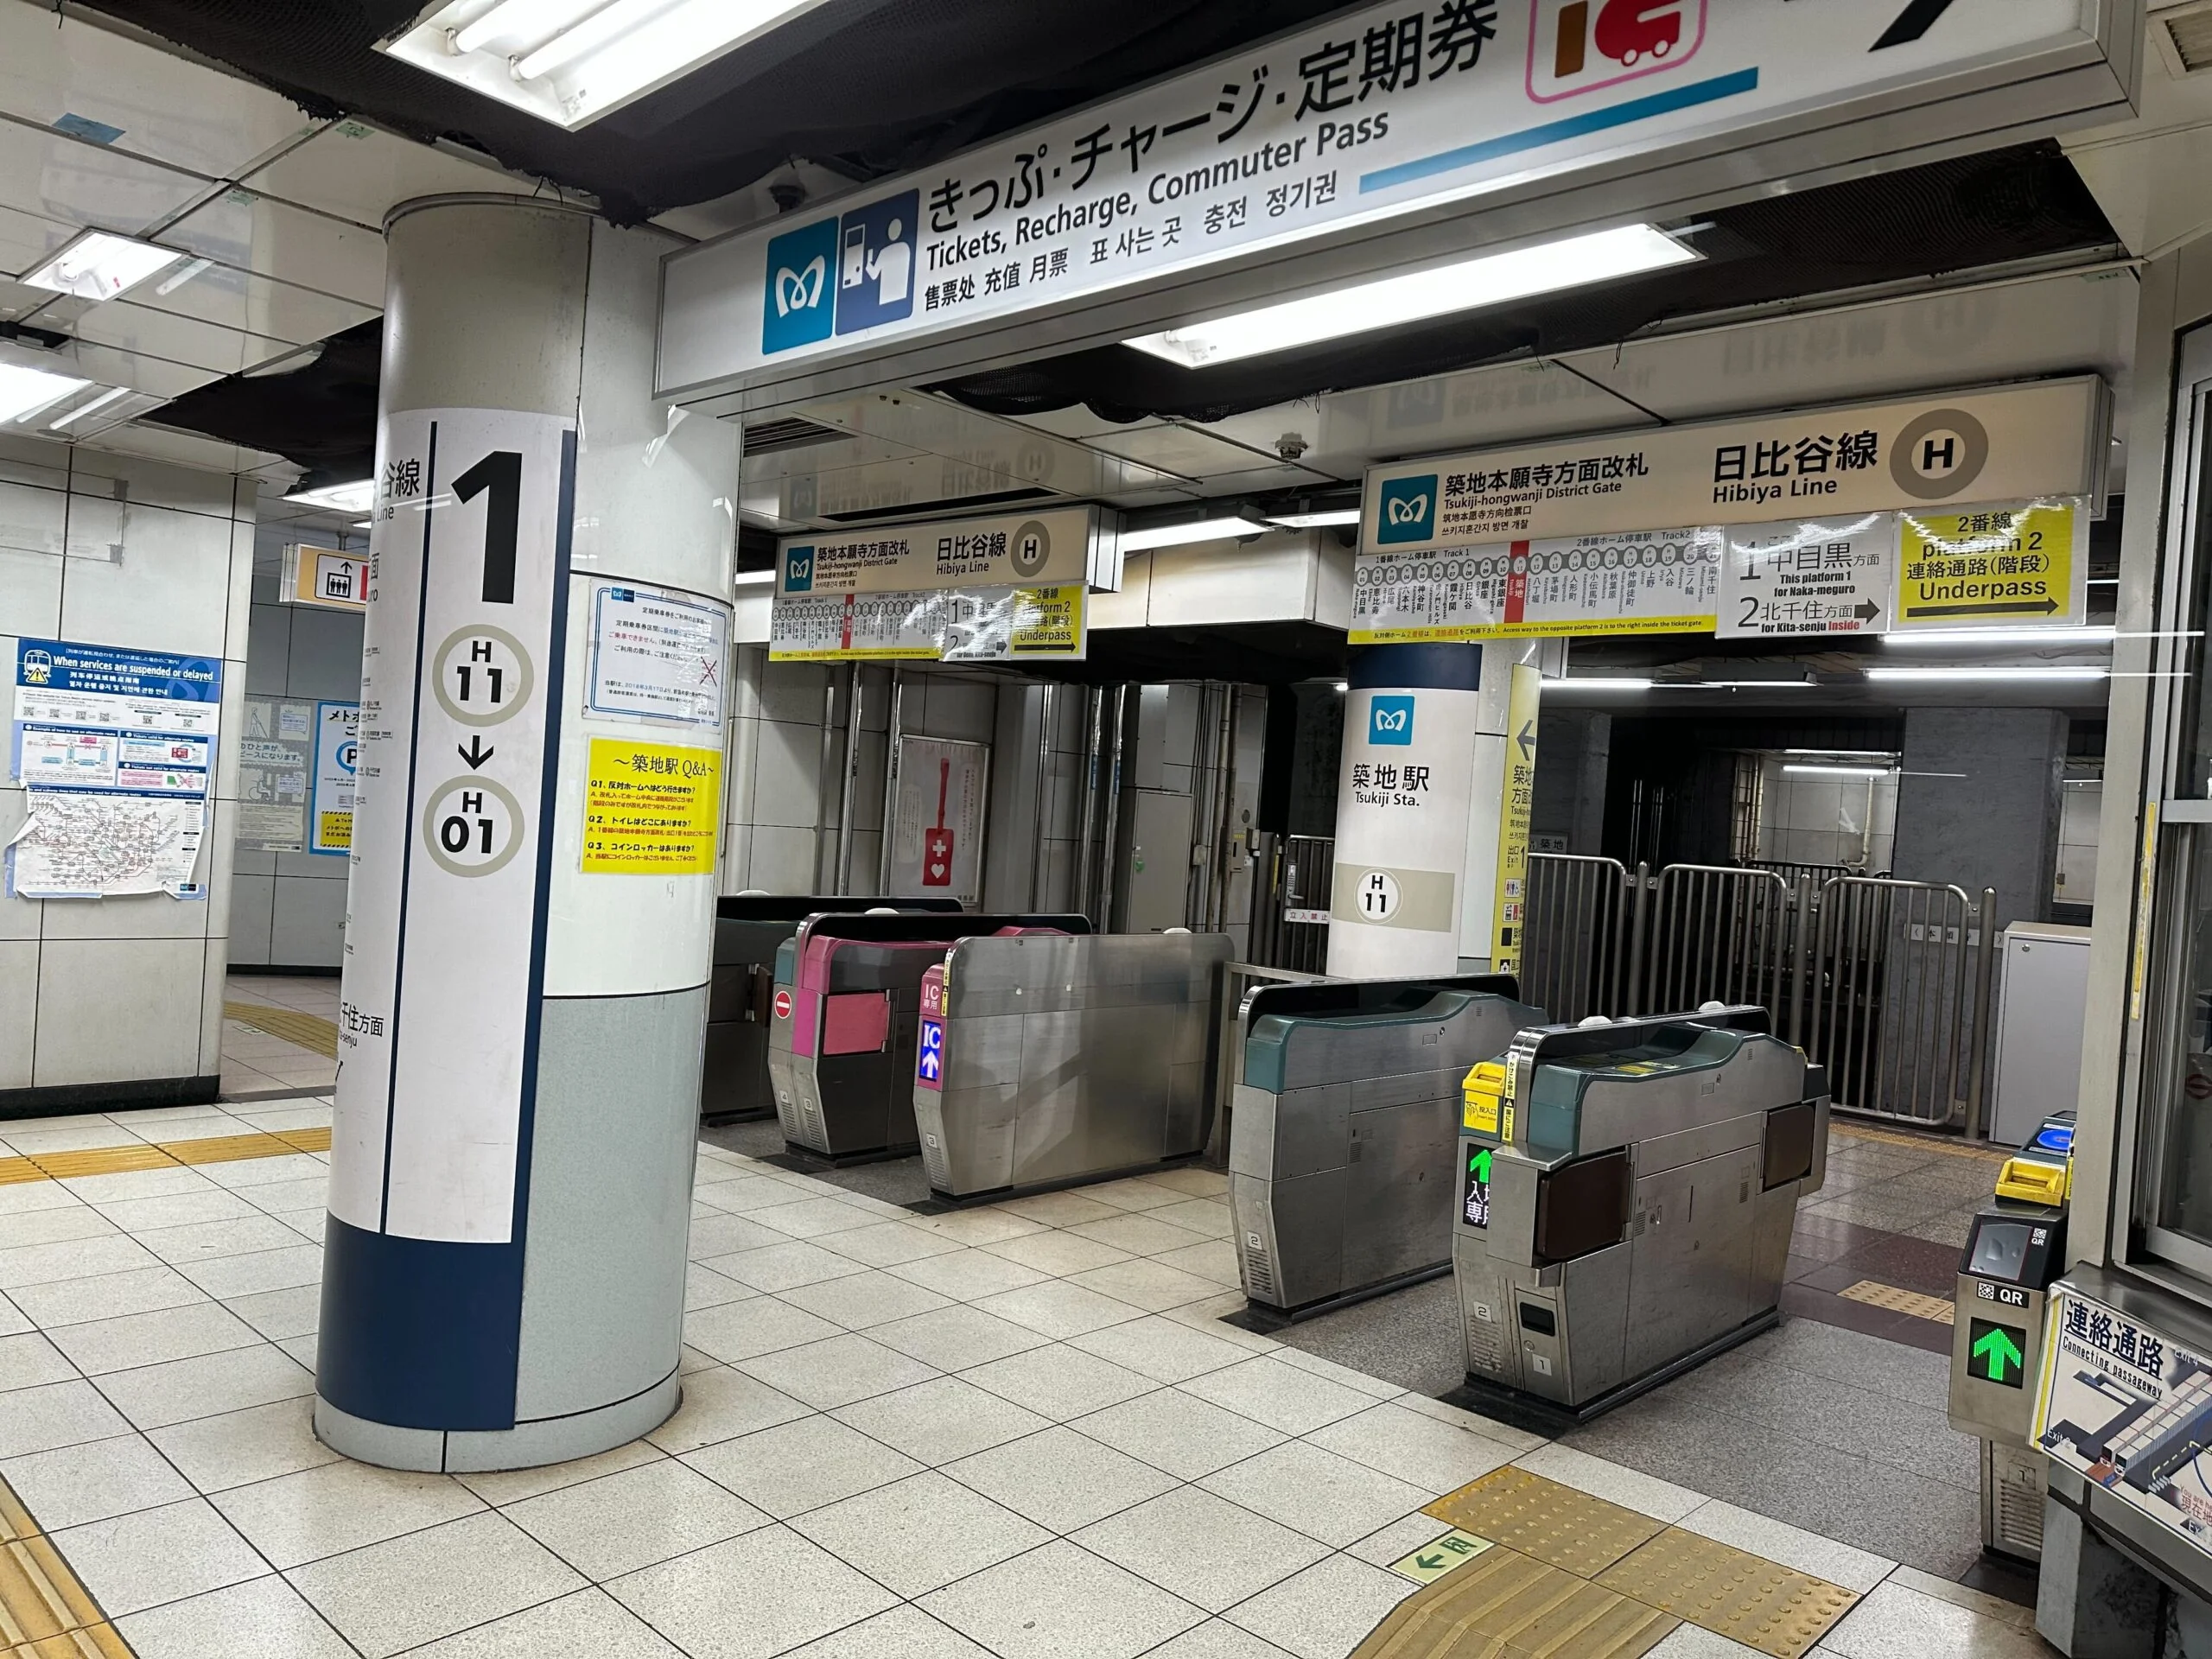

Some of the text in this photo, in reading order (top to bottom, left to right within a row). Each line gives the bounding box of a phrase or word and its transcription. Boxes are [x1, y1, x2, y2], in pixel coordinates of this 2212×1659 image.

[926, 111, 1389, 272] Tickets, Recharge, Commuter Pass
[1116, 226, 1154, 260] 사는
[1205, 194, 1248, 234] 충전
[1266, 170, 1338, 219] 정기권
[925, 249, 1068, 312] 售票处 充值 月票
[1713, 429, 1878, 484] 日比谷線
[1923, 438, 1955, 470] H
[1445, 452, 1649, 498] 築地本願寺方面改札
[1444, 481, 1622, 510] Tsukiji-hongwanji District Gate
[1713, 478, 1838, 505] Hibiya Line
[451, 451, 522, 604] 1
[1958, 512, 2012, 533] 2番線
[937, 532, 1007, 562] 日比谷線
[1024, 539, 1037, 559] H
[1923, 532, 2043, 561] pltfm 2
[864, 557, 883, 567] District
[936, 561, 989, 576] Hibiya Line
[1645, 571, 1656, 588] 上野
[1780, 571, 1851, 584] This platform 1
[1774, 584, 1856, 597] for Naka-meguro
[1919, 580, 2047, 601] Underpass
[1065, 601, 1071, 613] 2
[1738, 597, 1853, 627] 2 北千住方面
[1020, 631, 1071, 642] Underpass
[1761, 620, 1859, 633] for Kita-senju Inside
[471, 640, 492, 662] H
[53, 655, 213, 682] When services are suspended or delayed
[456, 665, 502, 703] 11
[1352, 763, 1430, 792] 築地駅
[462, 791, 482, 813] H
[1355, 791, 1420, 808] Tsukiji Sta.
[441, 815, 494, 854] 01
[1371, 875, 1383, 890] H
[1365, 893, 1387, 912] 11
[925, 984, 939, 1001] IC
[924, 1024, 941, 1049] IC
[2031, 1237, 2044, 1246] QR
[1999, 1288, 2024, 1306] QR
[2064, 1299, 2164, 1377] 連絡通路
[2063, 1335, 2163, 1401] Connecting passageway
[2047, 1428, 2063, 1444] Exit
